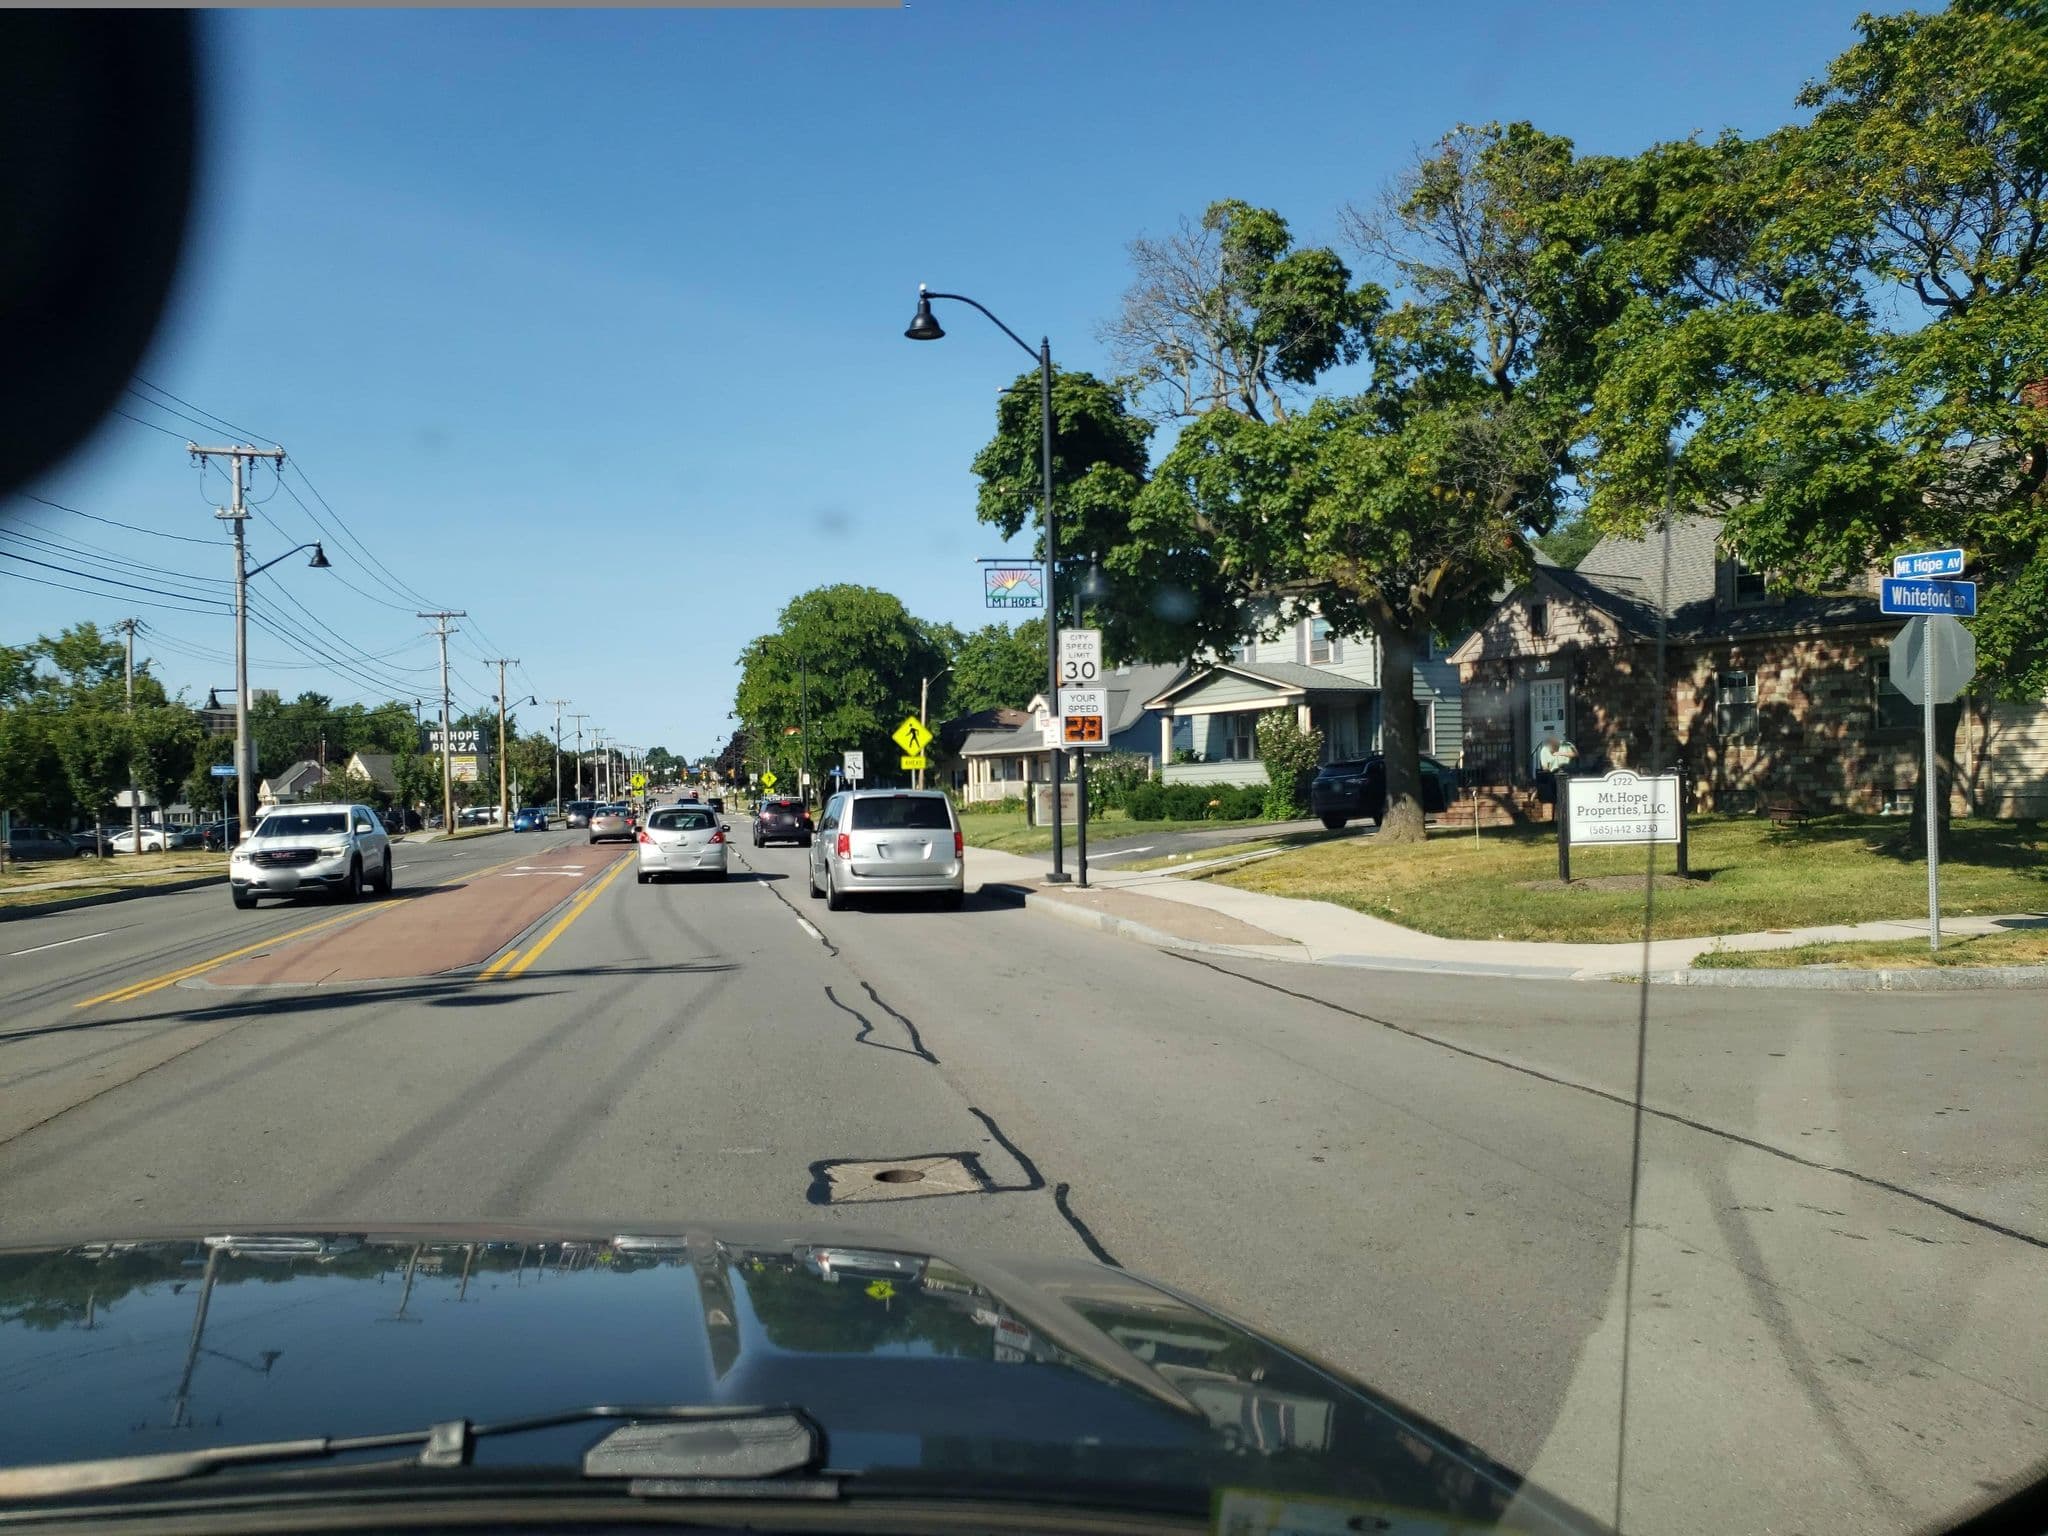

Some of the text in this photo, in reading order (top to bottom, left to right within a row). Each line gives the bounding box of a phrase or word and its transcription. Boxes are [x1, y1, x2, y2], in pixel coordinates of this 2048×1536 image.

[1914, 560, 1943, 573] Hope
[1947, 557, 1960, 569] AV
[1012, 597, 1037, 607] HOPE
[1892, 586, 1966, 608] Whiteford RD
[1065, 661, 1096, 679] 30
[1070, 694, 1096, 702] YOUR
[1068, 705, 1098, 713] SPEED
[1065, 716, 1101, 741] 28
[450, 731, 480, 741] HOPE
[433, 743, 477, 752] PLAZA
[1613, 778, 1632, 786] 1722
[1577, 805, 1641, 818] Properties,
